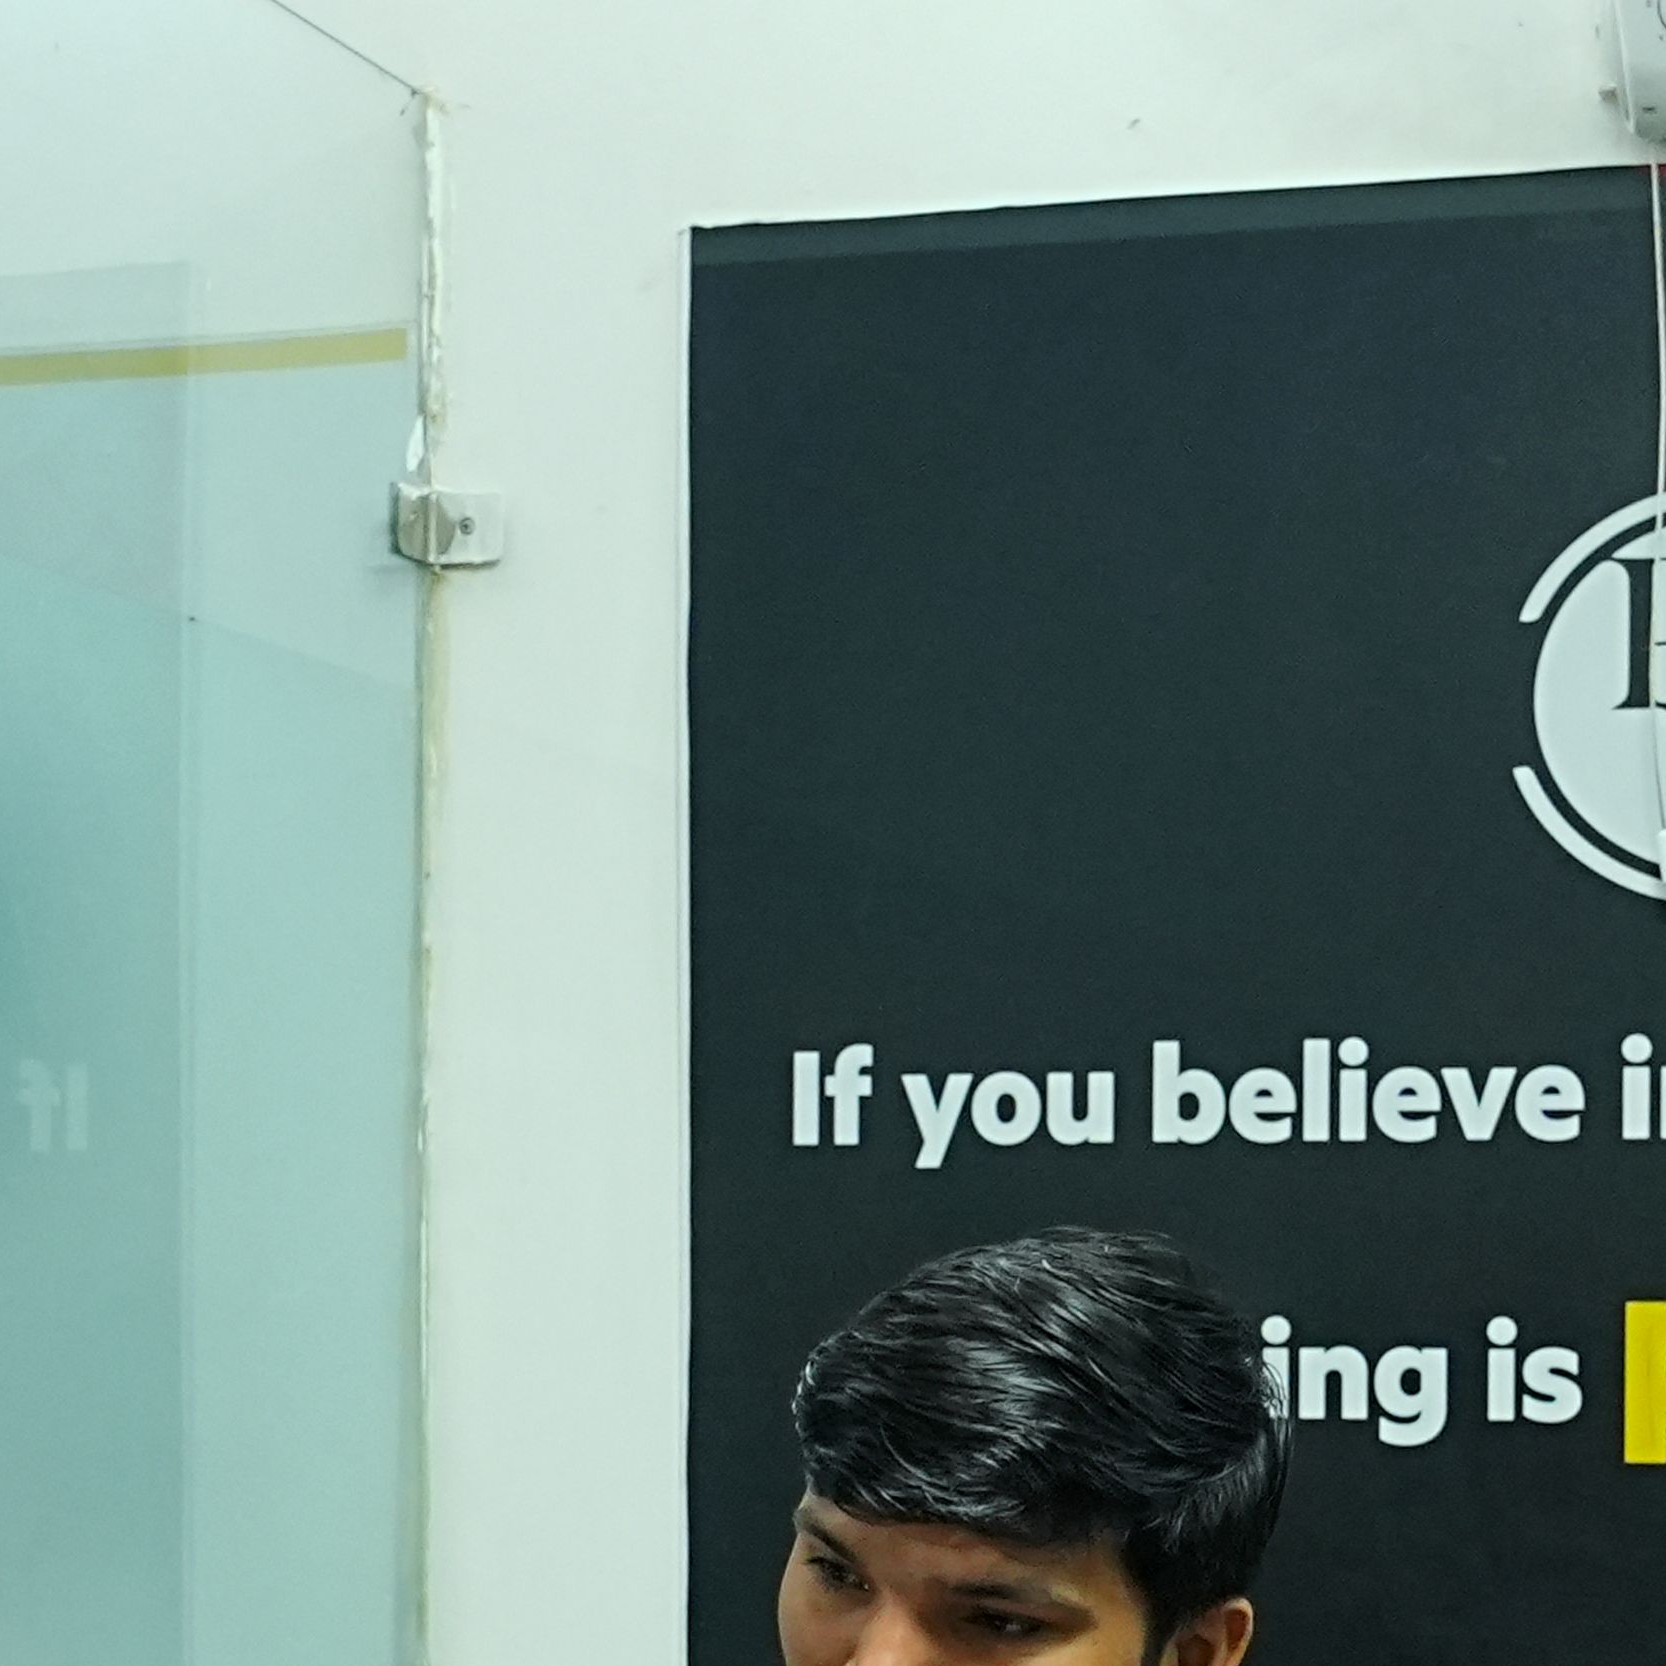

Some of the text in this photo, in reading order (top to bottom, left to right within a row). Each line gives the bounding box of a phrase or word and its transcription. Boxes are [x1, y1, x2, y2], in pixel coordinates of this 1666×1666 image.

[793, 1044, 873, 1145] If
[902, 1072, 1114, 1168] you
[1153, 1037, 1585, 1143] believe
[1487, 1317, 1582, 1423] is
